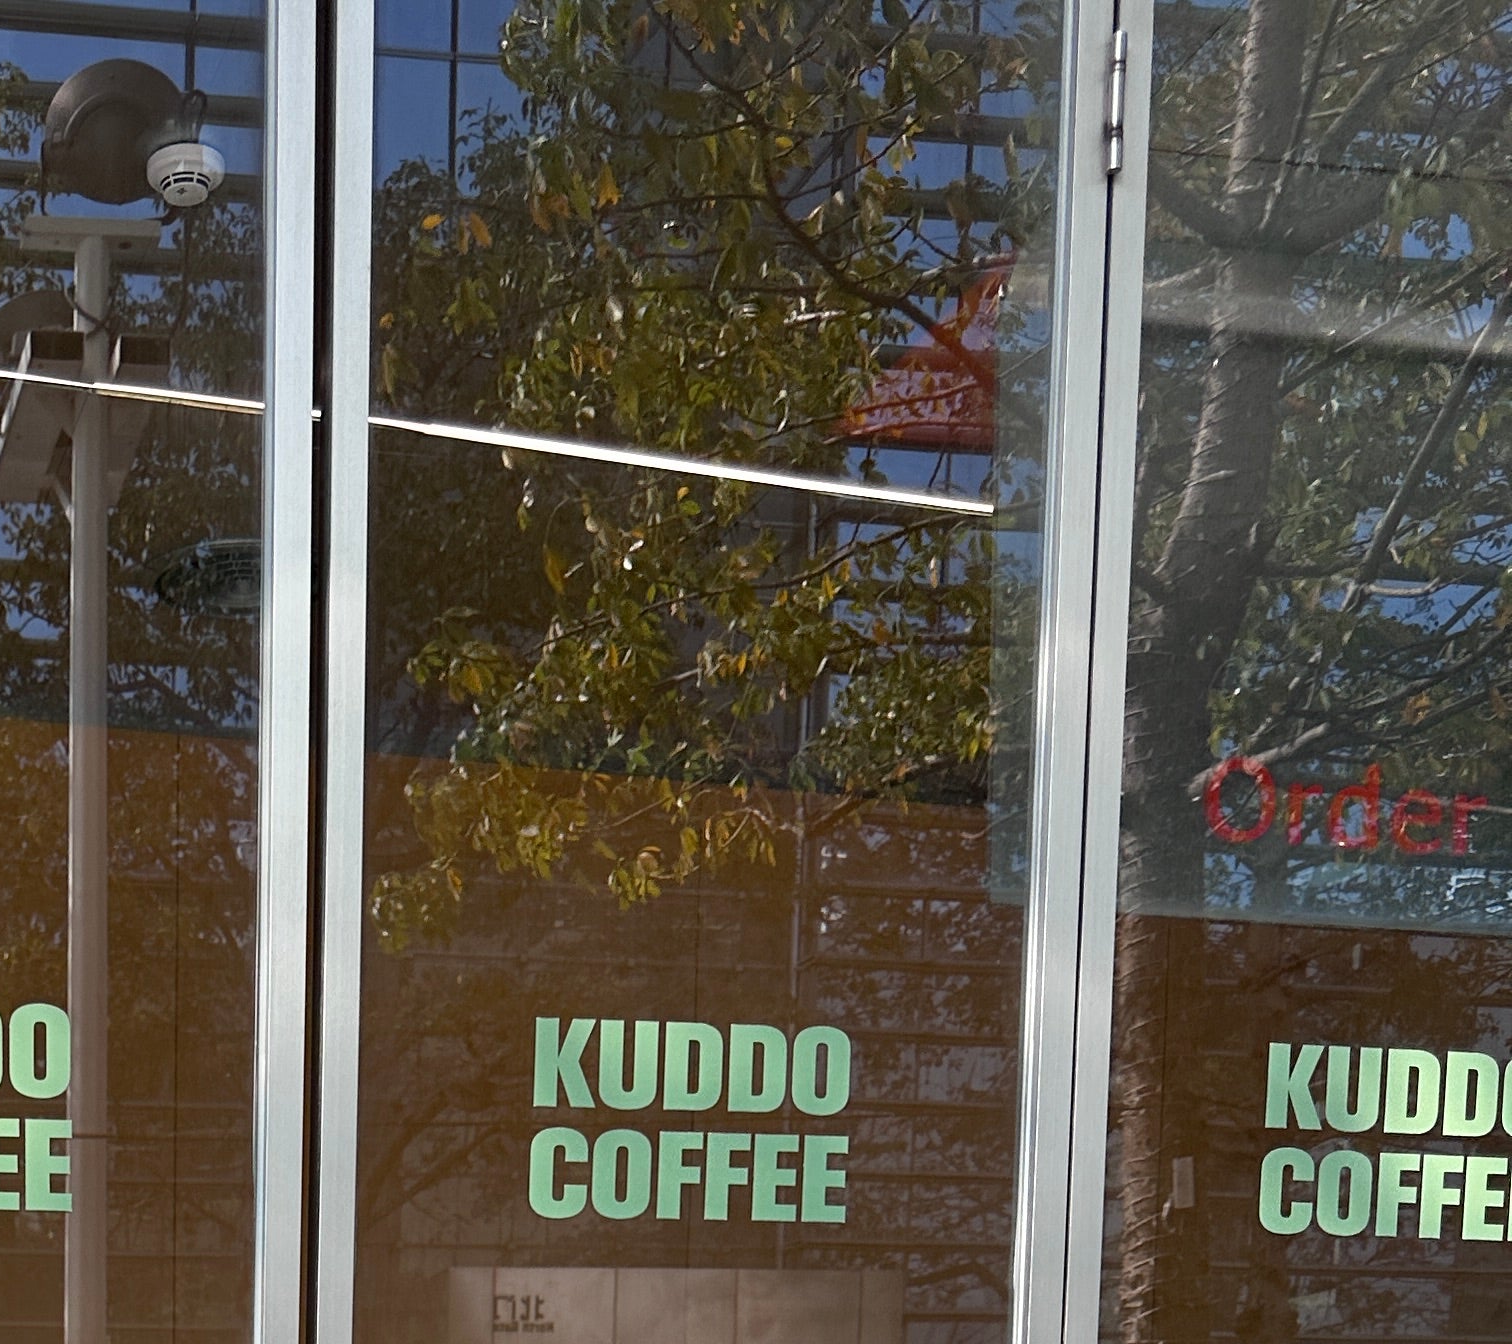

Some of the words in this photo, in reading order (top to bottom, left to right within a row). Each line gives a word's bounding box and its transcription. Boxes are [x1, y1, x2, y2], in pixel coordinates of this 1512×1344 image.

[1205, 756, 1487, 857] Order
[533, 1016, 852, 1117] KUDDO
[1264, 1042, 1512, 1138] KUDD
[528, 1126, 850, 1224] COFFEE
[1258, 1146, 1512, 1242] COFFE
